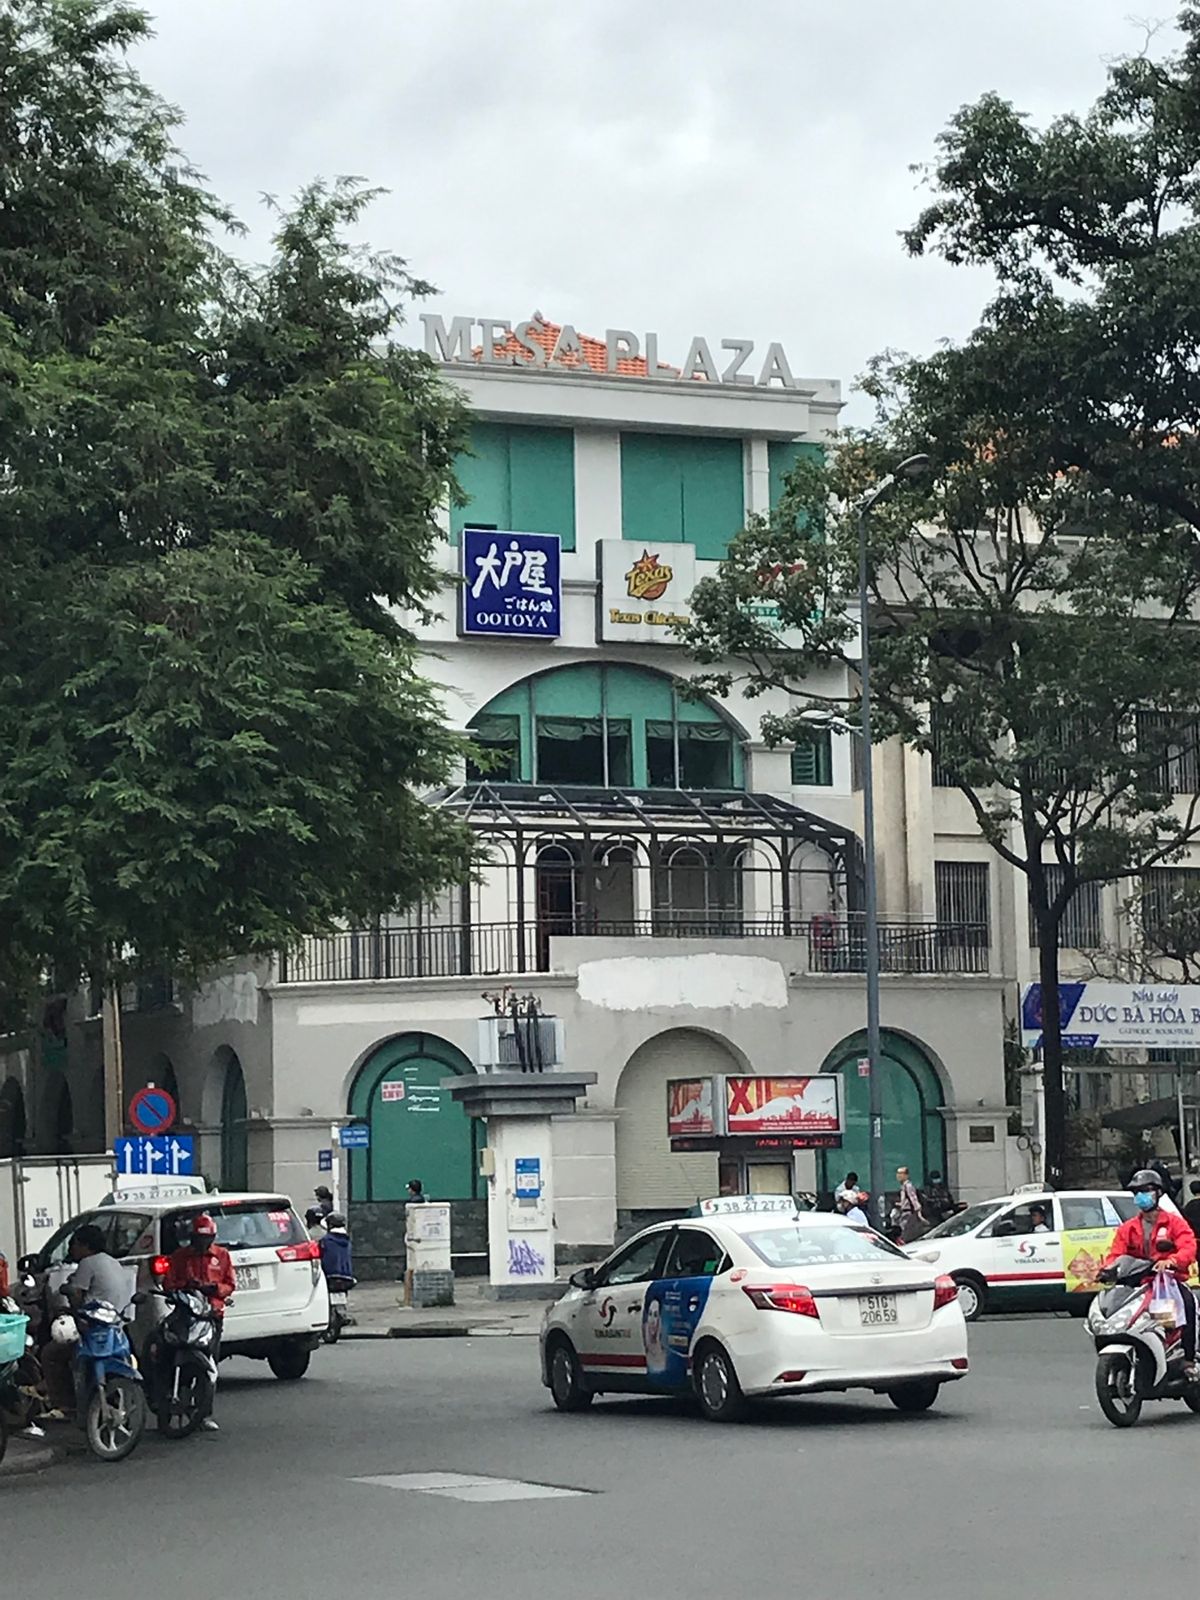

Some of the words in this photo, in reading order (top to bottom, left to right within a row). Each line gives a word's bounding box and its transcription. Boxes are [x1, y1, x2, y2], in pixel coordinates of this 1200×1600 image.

[419, 313, 593, 373] MESA
[605, 328, 797, 389] PLAZA
[625, 565, 673, 597] Texas
[476, 612, 548, 628] OOTOYA
[610, 607, 642, 624] Texas
[1079, 1003, 1118, 1023] ĐỨC
[723, 1202, 740, 1212] 38
[744, 1200, 758, 1211] 27
[761, 1199, 775, 1210] 27
[780, 1199, 793, 1210] 27
[867, 1295, 889, 1310] 51G
